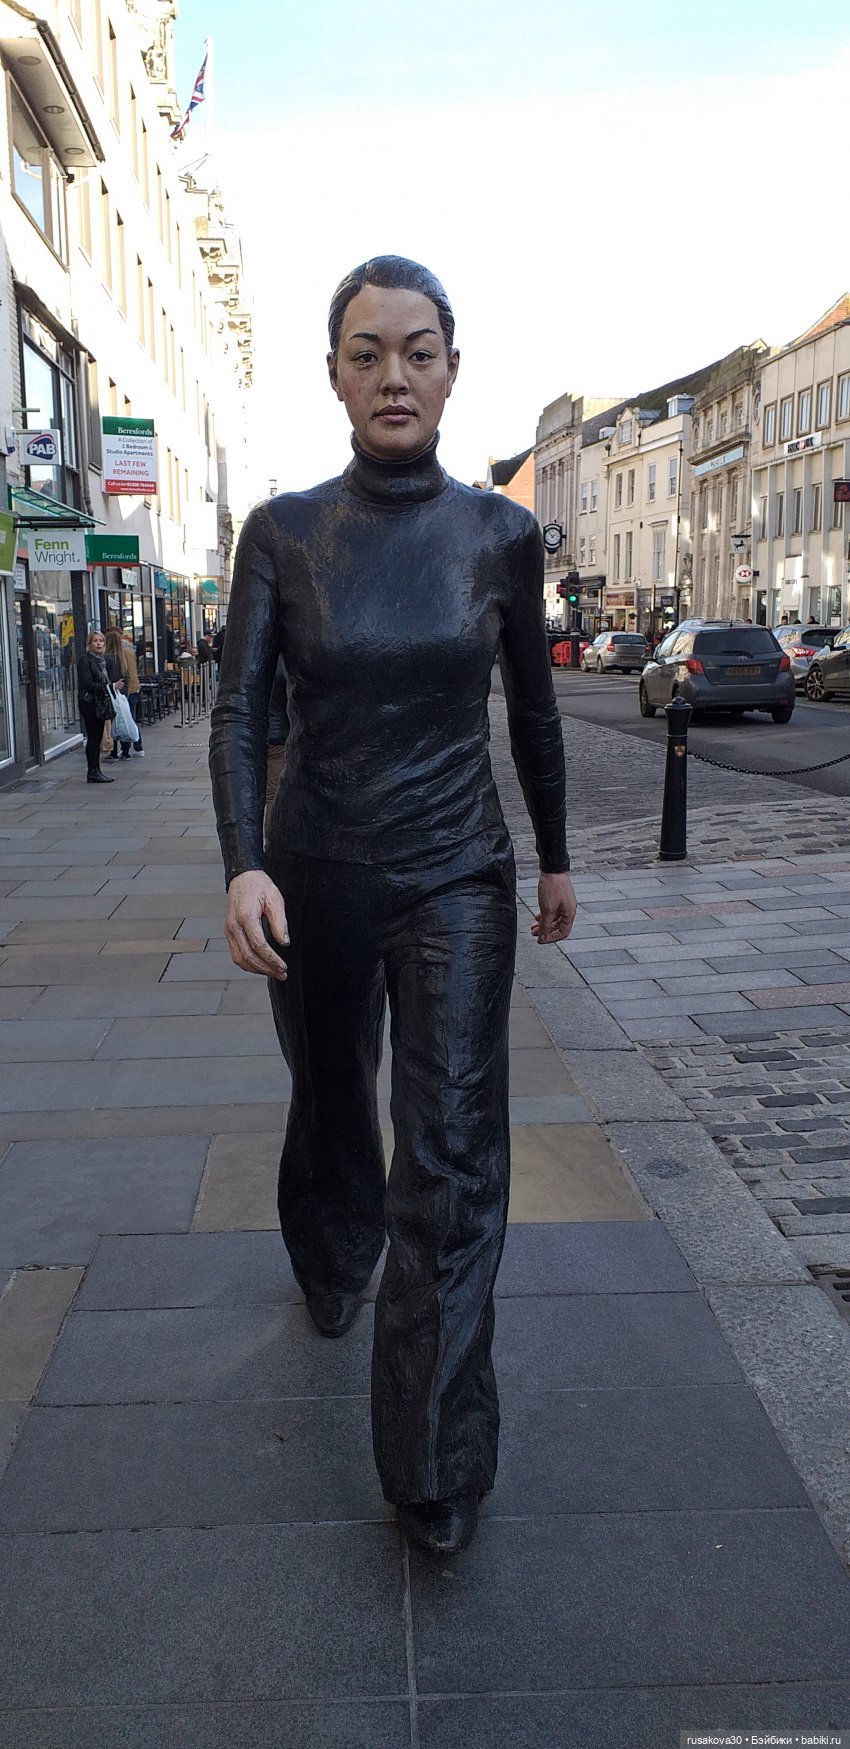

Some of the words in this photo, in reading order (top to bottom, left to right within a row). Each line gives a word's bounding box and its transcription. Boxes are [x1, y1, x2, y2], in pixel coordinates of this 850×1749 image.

[117, 426, 153, 436] Beresfords
[29, 443, 56, 455] PAB
[112, 468, 149, 476] REMAINING
[34, 538, 69, 550] Fenn
[102, 552, 137, 560] Beresfords
